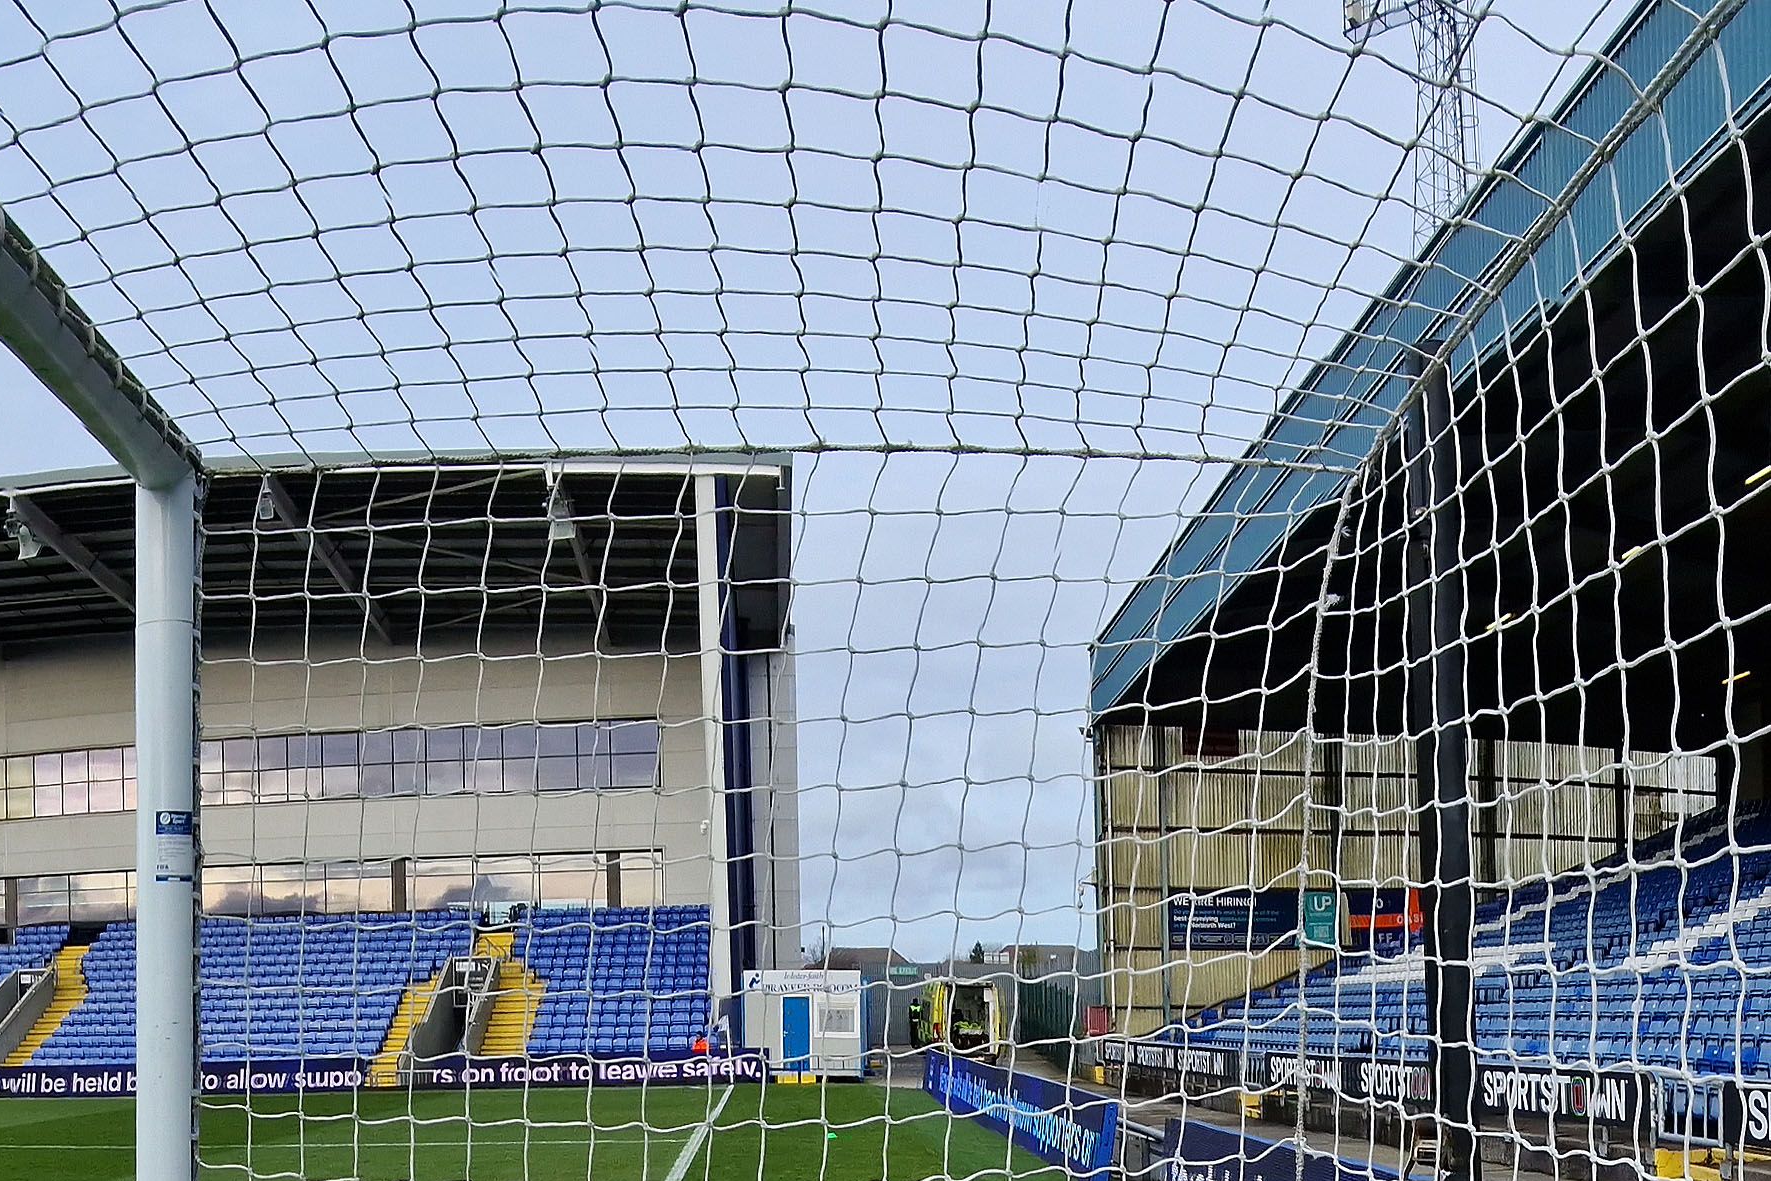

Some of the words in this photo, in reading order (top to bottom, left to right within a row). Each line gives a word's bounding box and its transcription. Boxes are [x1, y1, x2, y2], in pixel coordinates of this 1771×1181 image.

[1314, 896, 1332, 912] UP
[226, 1069, 287, 1090] allow
[461, 1067, 495, 1084] on
[499, 1062, 560, 1082] foot
[569, 1062, 592, 1081] to
[599, 1063, 678, 1080] leave
[683, 1055, 761, 1078] safely.
[1360, 1062, 1431, 1101] SPORTSTO
[1, 1073, 36, 1093] will
[41, 1073, 66, 1093] be
[72, 1072, 121, 1093] held
[1483, 1070, 1627, 1122] SPORTSTOWN
